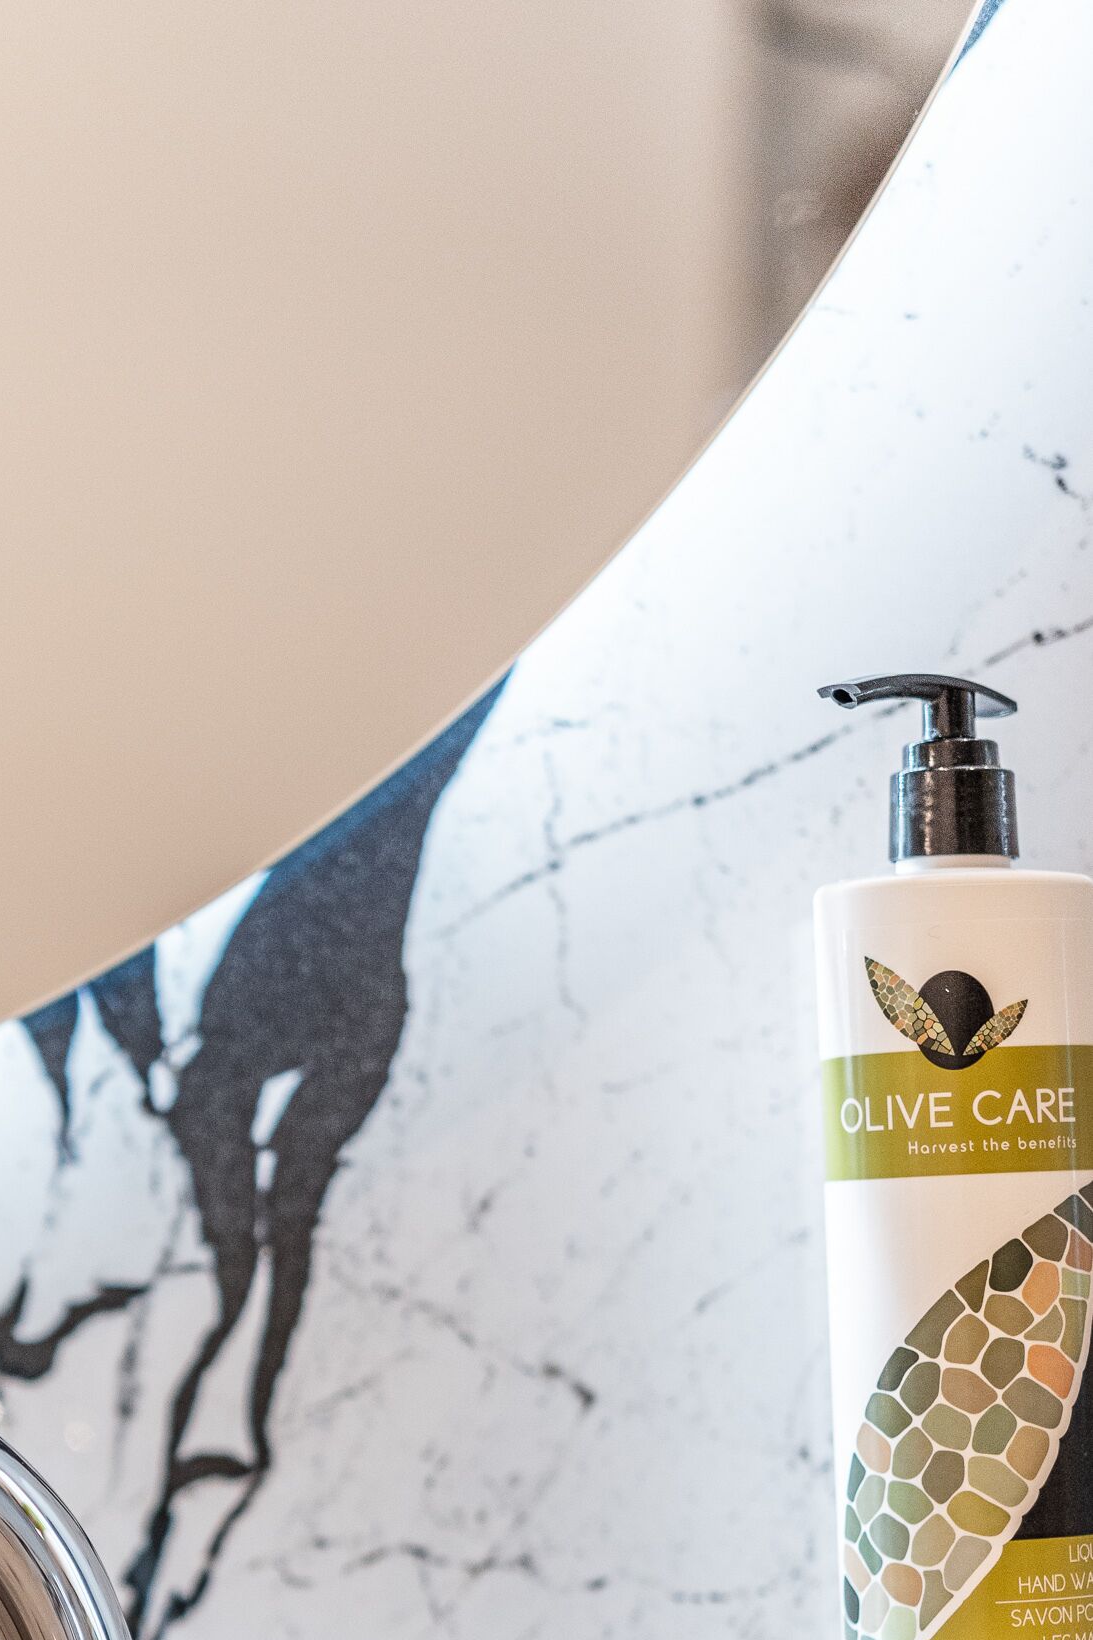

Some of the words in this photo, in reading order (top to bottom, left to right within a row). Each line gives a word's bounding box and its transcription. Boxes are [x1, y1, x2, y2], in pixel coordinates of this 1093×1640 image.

[840, 1091, 954, 1134] OLIVE
[972, 1087, 1077, 1126] CARE
[908, 1140, 974, 1155] Harvest
[983, 1138, 1010, 1151] the
[1018, 1136, 1077, 1150] benefits
[1018, 1573, 1066, 1594] HAND
[1010, 1604, 1073, 1628] SAVON
